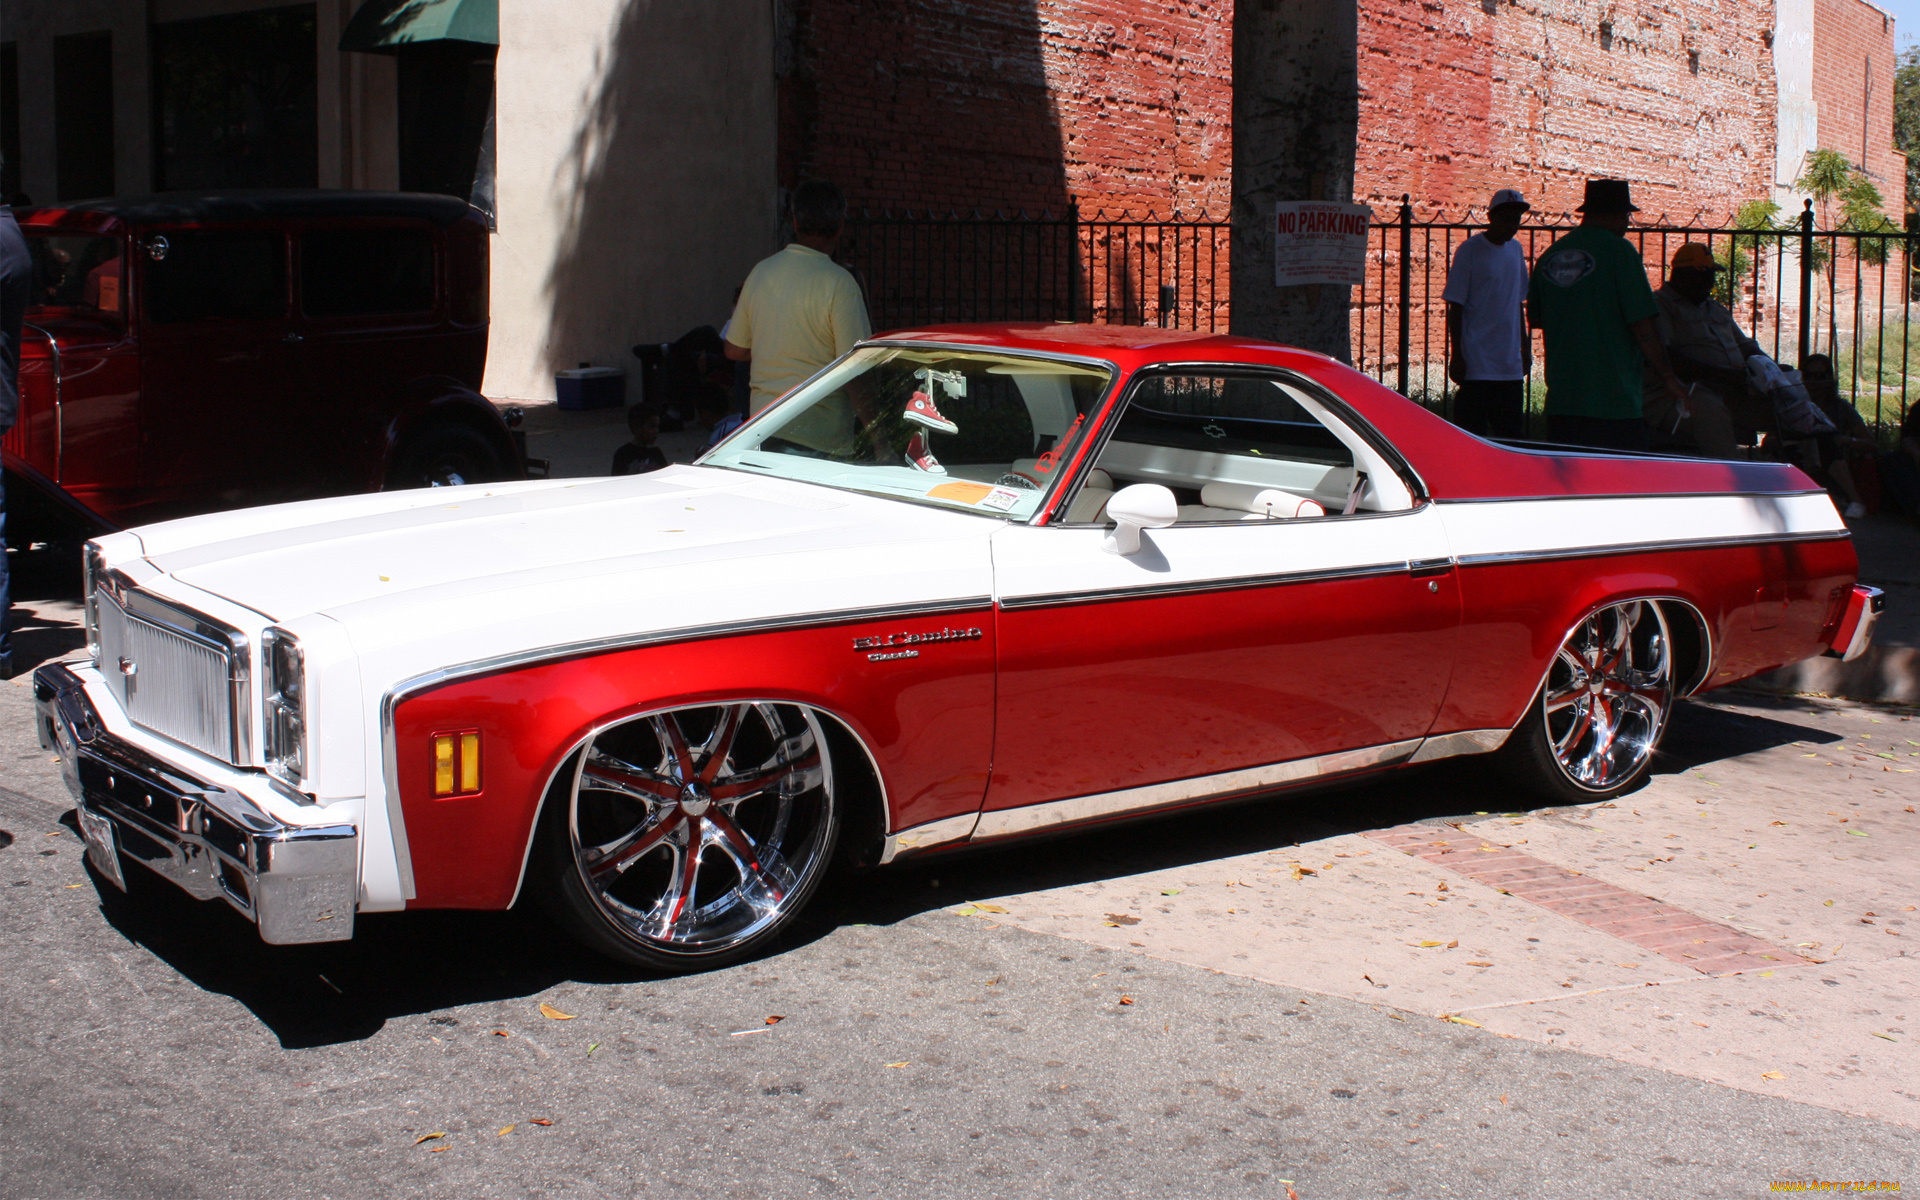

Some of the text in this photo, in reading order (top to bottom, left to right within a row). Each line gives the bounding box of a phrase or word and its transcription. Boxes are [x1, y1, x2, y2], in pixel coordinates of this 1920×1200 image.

[1278, 212, 1367, 235] NO PARKING
[1326, 233, 1347, 241] ZONE
[853, 627, 983, 648] El Camino
